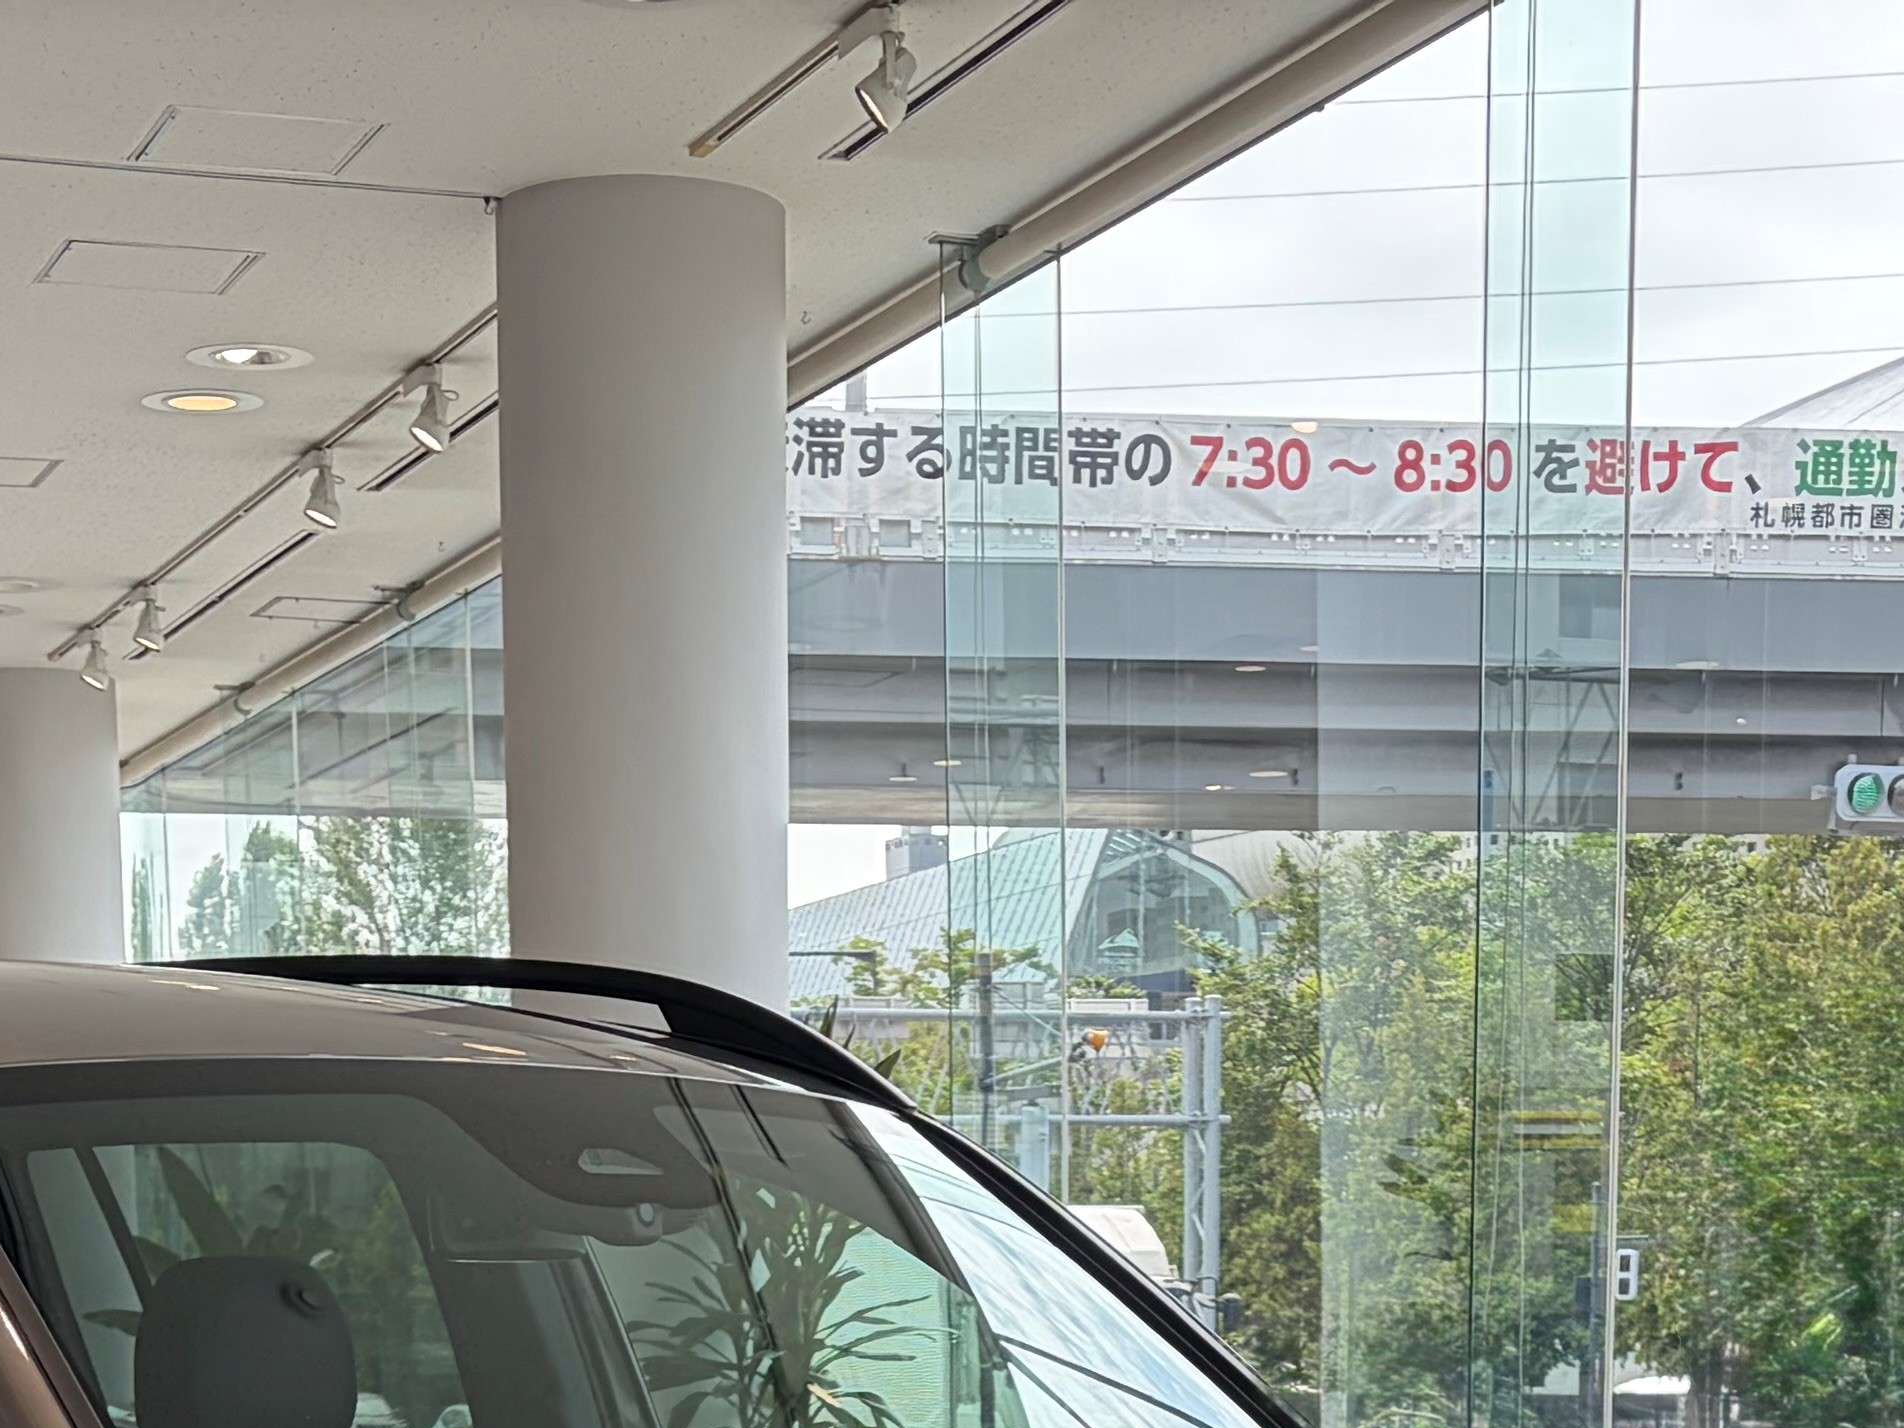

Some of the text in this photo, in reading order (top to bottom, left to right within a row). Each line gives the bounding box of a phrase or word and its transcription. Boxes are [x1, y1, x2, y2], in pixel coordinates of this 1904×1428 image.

[786, 416, 1172, 488] 滞する時間帯の
[1189, 434, 1312, 492] 7:30
[1393, 438, 1514, 494] 8:30
